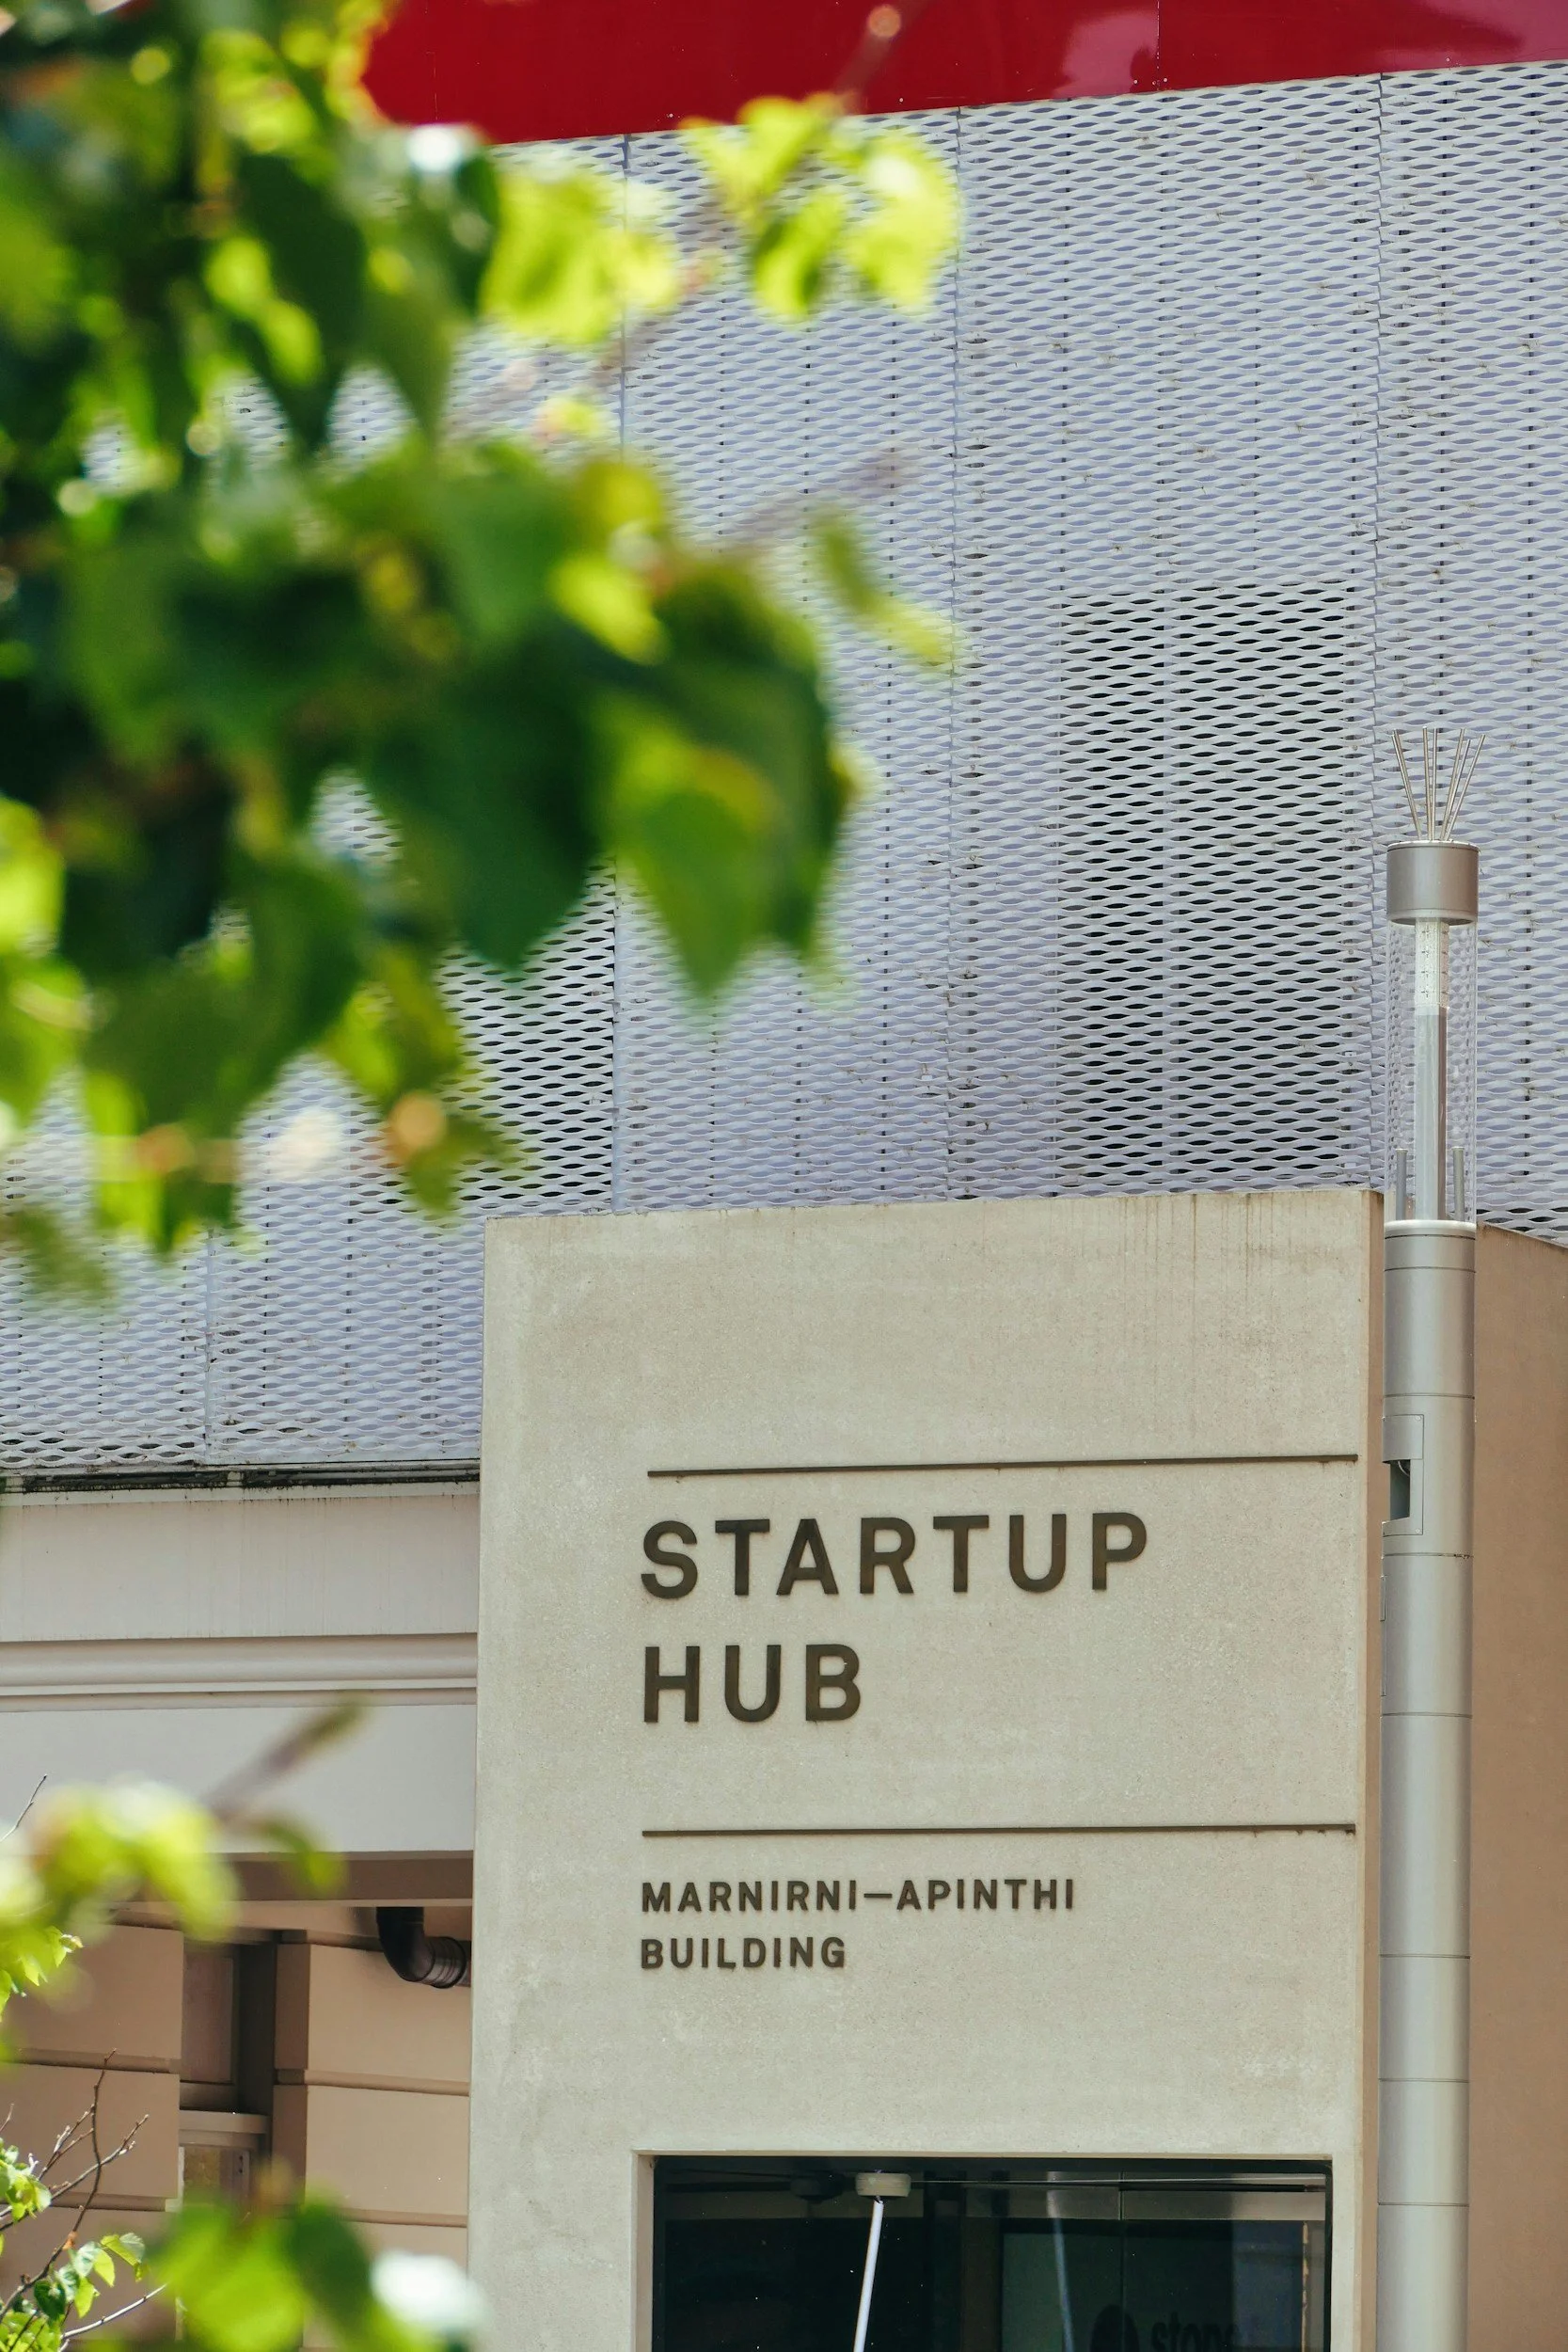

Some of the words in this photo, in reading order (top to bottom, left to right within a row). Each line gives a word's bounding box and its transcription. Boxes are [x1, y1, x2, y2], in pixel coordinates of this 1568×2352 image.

[641, 1512, 1148, 1600] STARTUP
[643, 1643, 862, 1724] HUB
[641, 1936, 846, 1970] BUILDING
